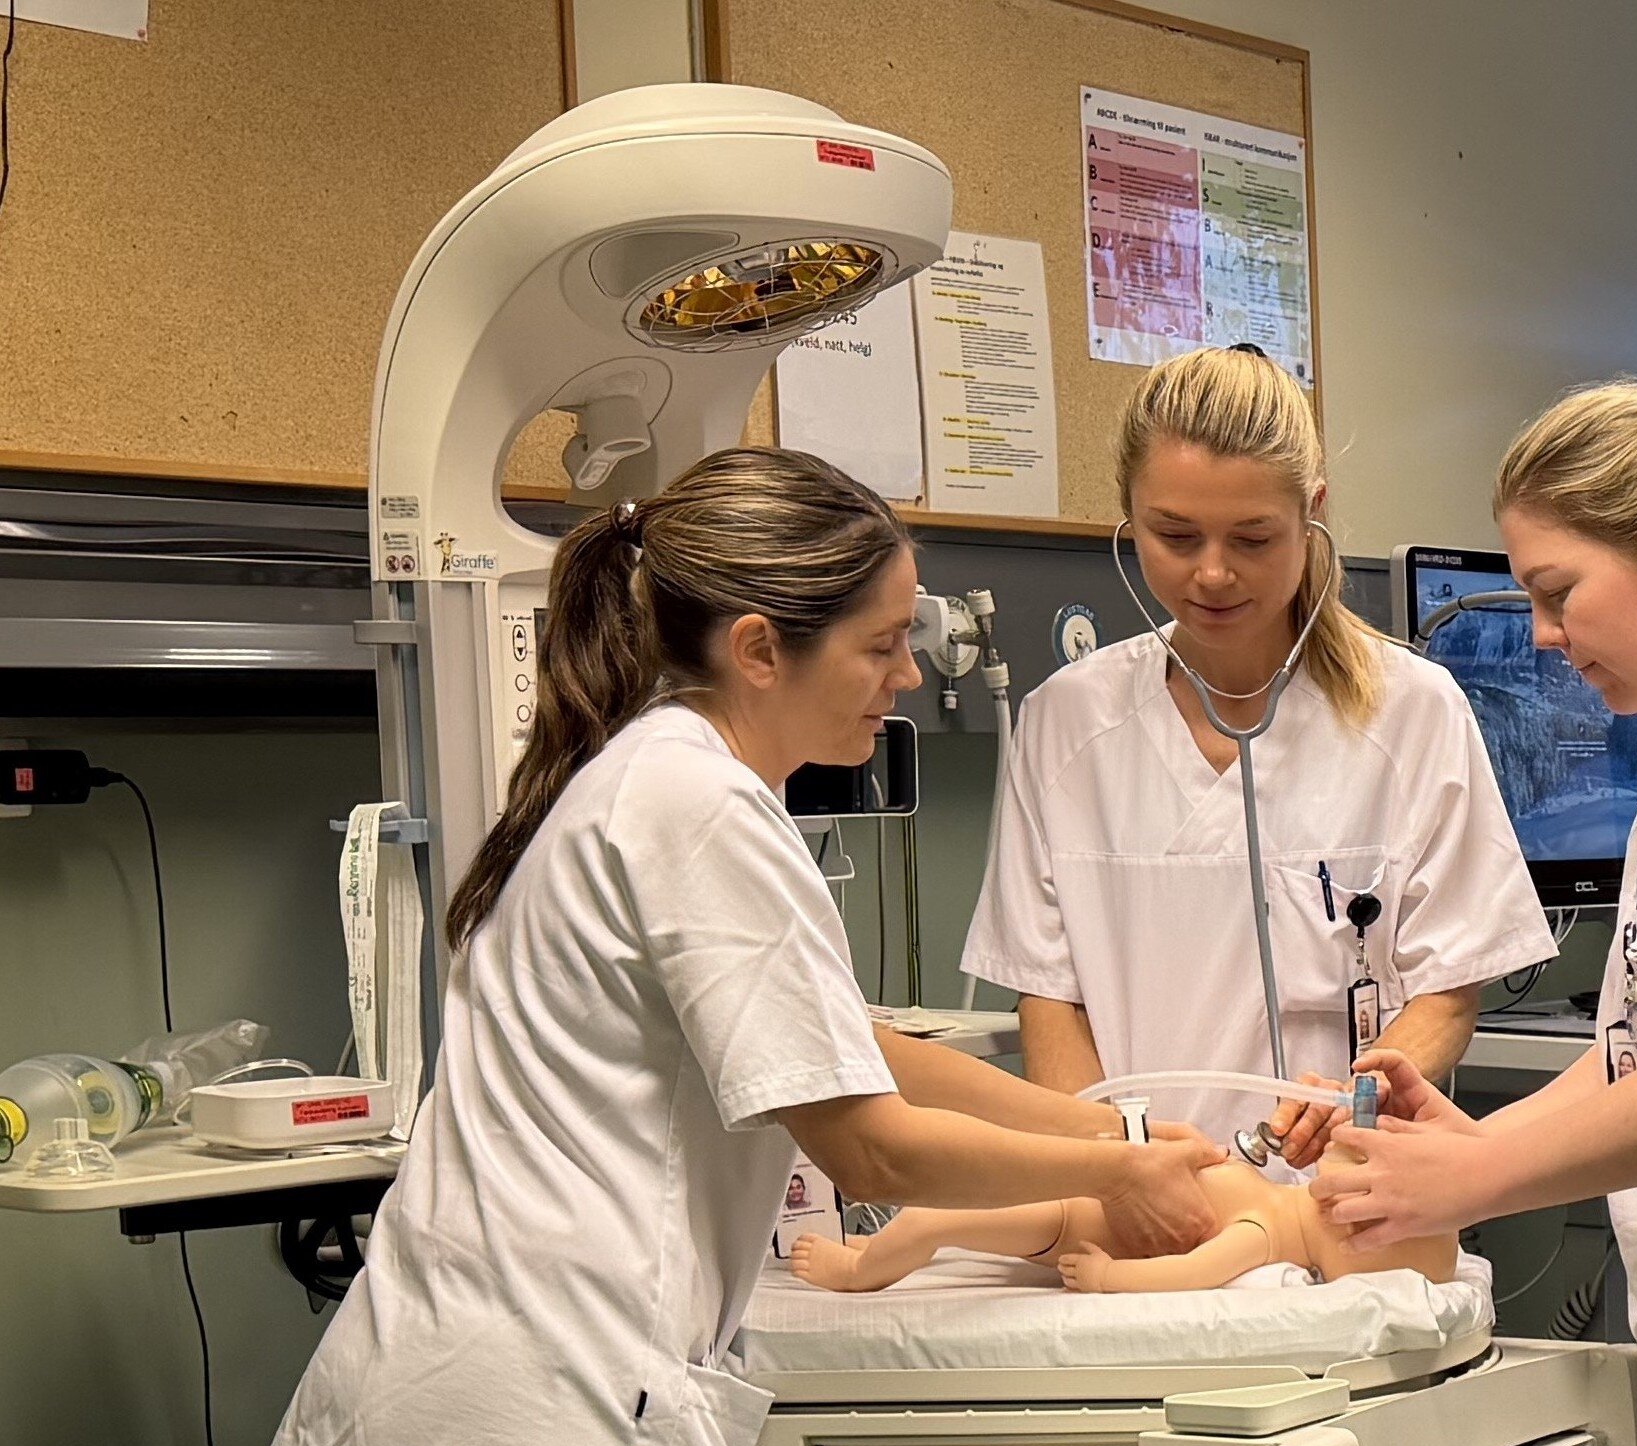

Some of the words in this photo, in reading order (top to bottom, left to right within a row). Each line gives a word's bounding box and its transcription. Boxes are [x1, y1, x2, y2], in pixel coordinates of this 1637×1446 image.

[1088, 134, 1097, 150] A
[1089, 164, 1097, 179] B
[1203, 188, 1209, 202] S
[1090, 196, 1098, 211] C
[1205, 218, 1211, 232] B
[1092, 233, 1100, 248] D
[1205, 255, 1213, 270] A
[1093, 282, 1100, 298] E
[1206, 301, 1214, 316] R
[451, 554, 494, 570] Giraffe
